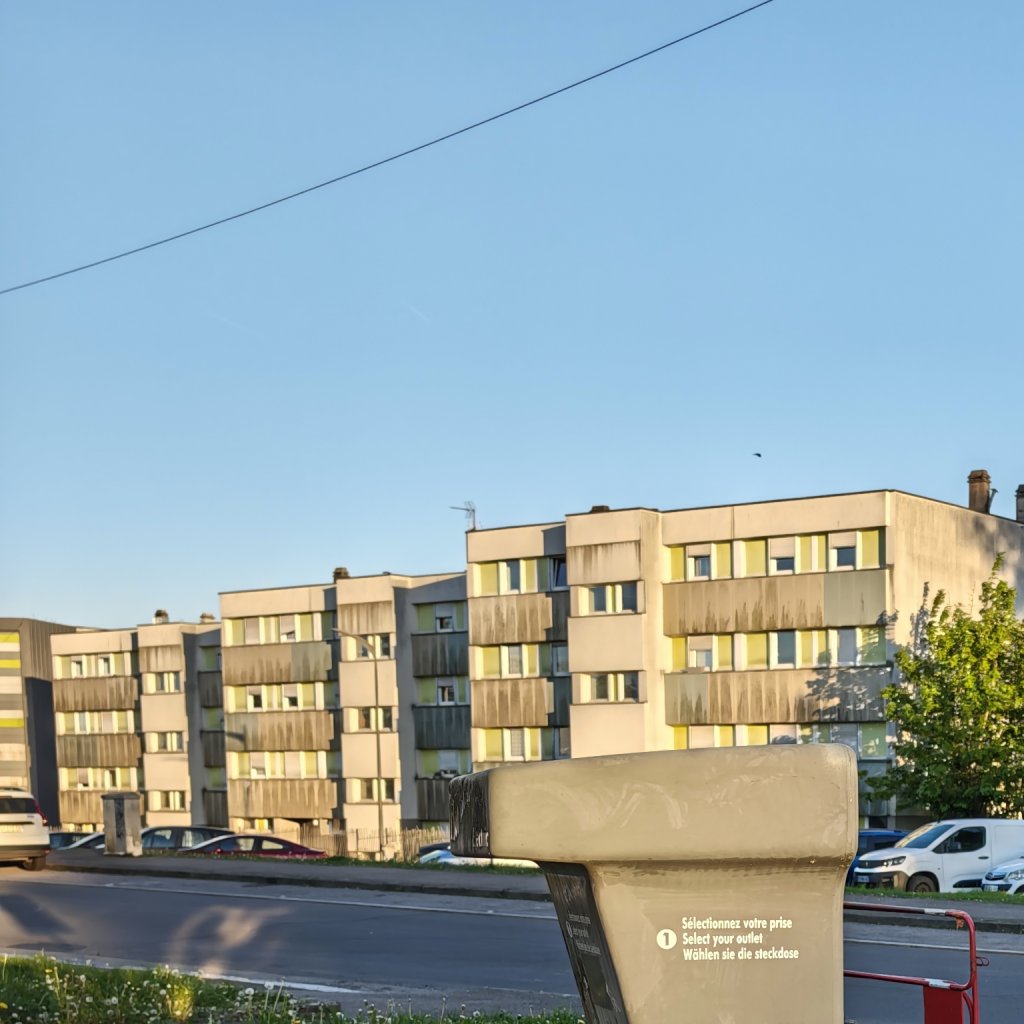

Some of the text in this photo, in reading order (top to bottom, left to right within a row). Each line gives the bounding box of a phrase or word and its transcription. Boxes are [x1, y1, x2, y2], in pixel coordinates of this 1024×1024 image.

[681, 916, 793, 931] Sélectionnez votre prise
[682, 932, 711, 945] Select
[712, 934, 735, 947] your
[736, 931, 763, 945] outlet
[683, 947, 800, 961] Wählen sie die steckdose
